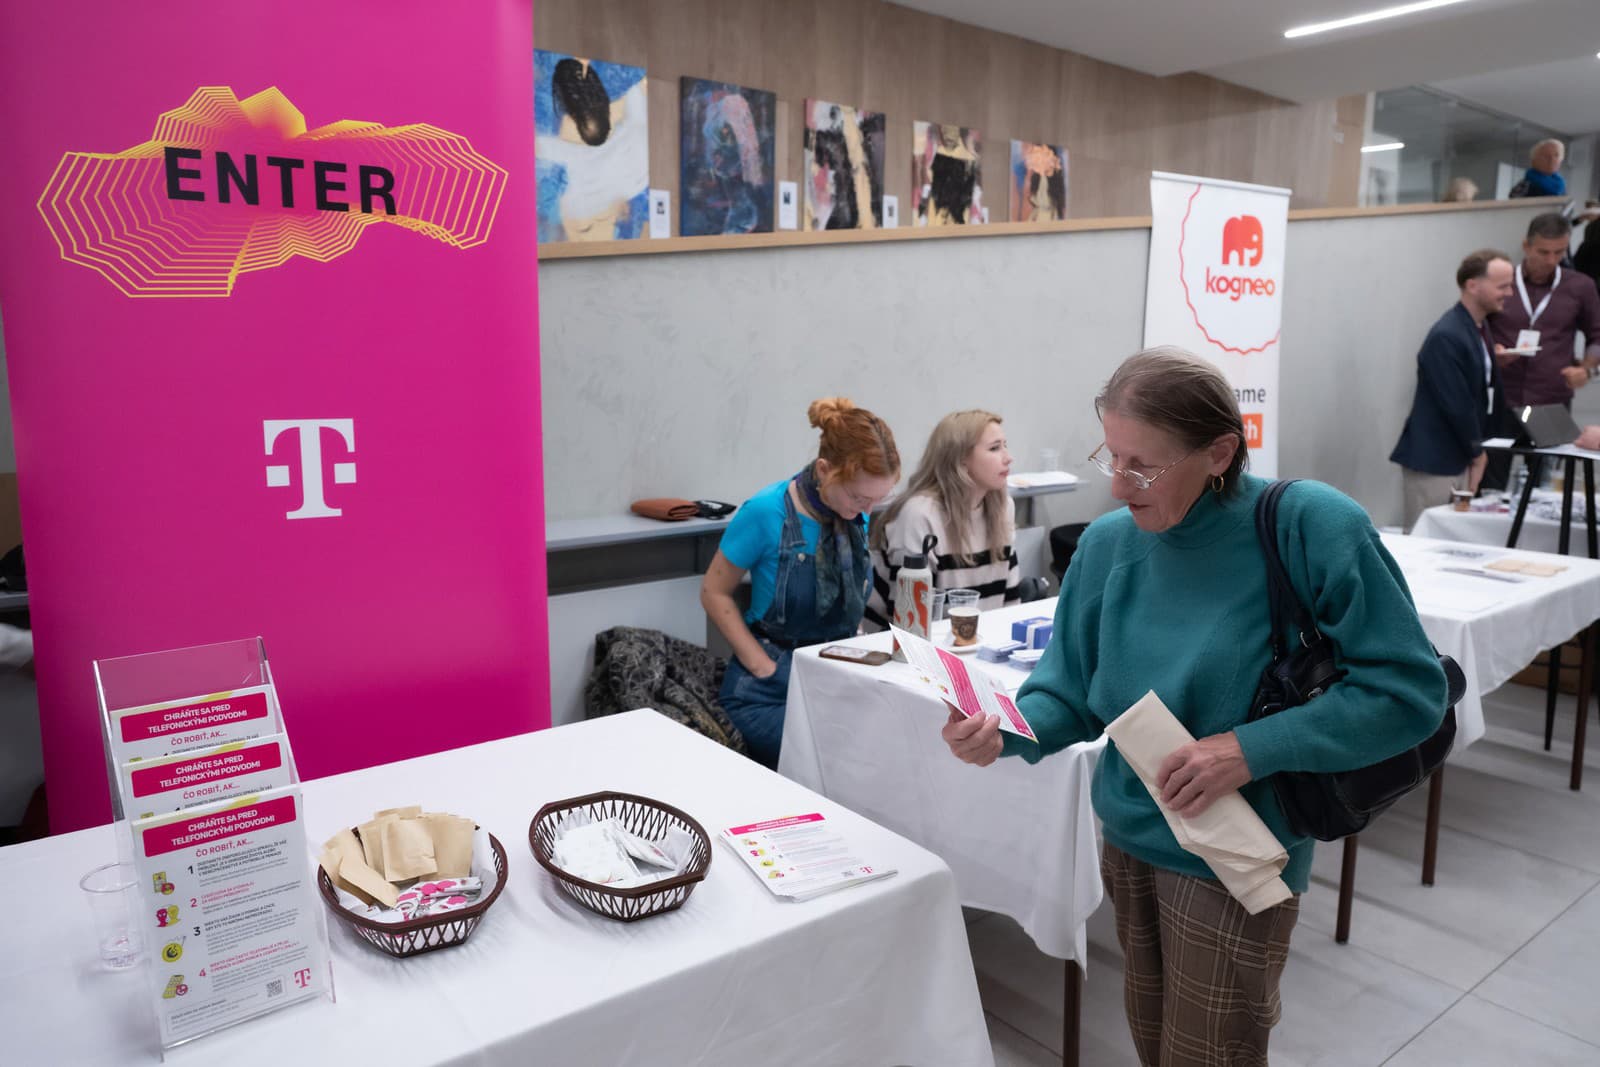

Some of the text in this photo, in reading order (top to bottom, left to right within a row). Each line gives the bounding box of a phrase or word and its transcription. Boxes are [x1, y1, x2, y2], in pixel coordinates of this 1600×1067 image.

[164, 146, 397, 216] ENTER
[1206, 266, 1275, 302] kogneo
[263, 418, 356, 520] T
[147, 710, 248, 734] TELEFONICKÝMI PODVODMI
[163, 703, 231, 722] CHRÁŇTE SA PRED
[171, 735, 183, 746] ČO
[160, 760, 261, 788] TELEFONICKÝMI PODVODMI
[175, 754, 244, 775] CHRÁŇTE SA PRED
[183, 788, 196, 800] ČO
[171, 815, 275, 846] TELEFONICKÝMI PODVODMI
[188, 809, 258, 832] CHRÁŇTE SA PRED
[195, 847, 208, 858] ČO
[187, 865, 194, 875] 1
[190, 898, 198, 908] 2
[193, 926, 201, 936] 3
[199, 968, 206, 977] 4
[294, 968, 311, 989] T
